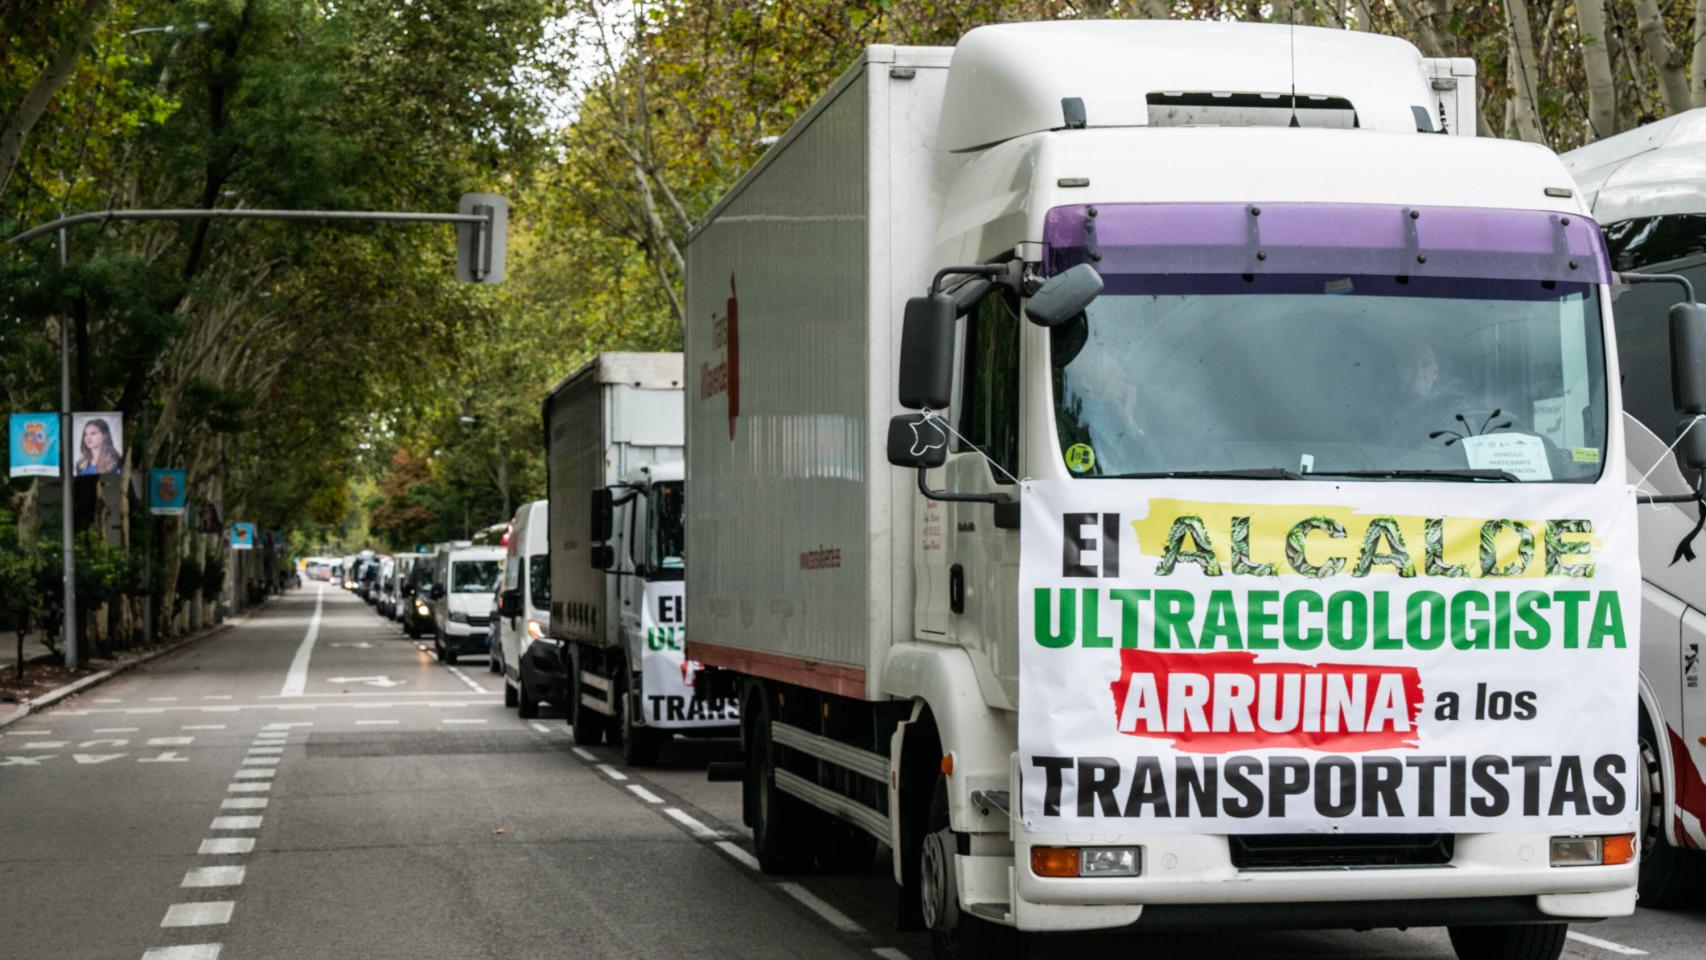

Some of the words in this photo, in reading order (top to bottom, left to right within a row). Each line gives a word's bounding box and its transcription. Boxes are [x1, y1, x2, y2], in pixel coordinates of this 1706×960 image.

[1063, 512, 1119, 577] El
[1155, 515, 1597, 578] ALCALDE
[1034, 588, 1627, 650] ULTRAECOLOGISTA
[1119, 672, 1411, 733] ARRUINA
[1435, 691, 1459, 720] a
[1476, 683, 1537, 720] los
[1032, 754, 1626, 818] TRANSPORTISTAS
